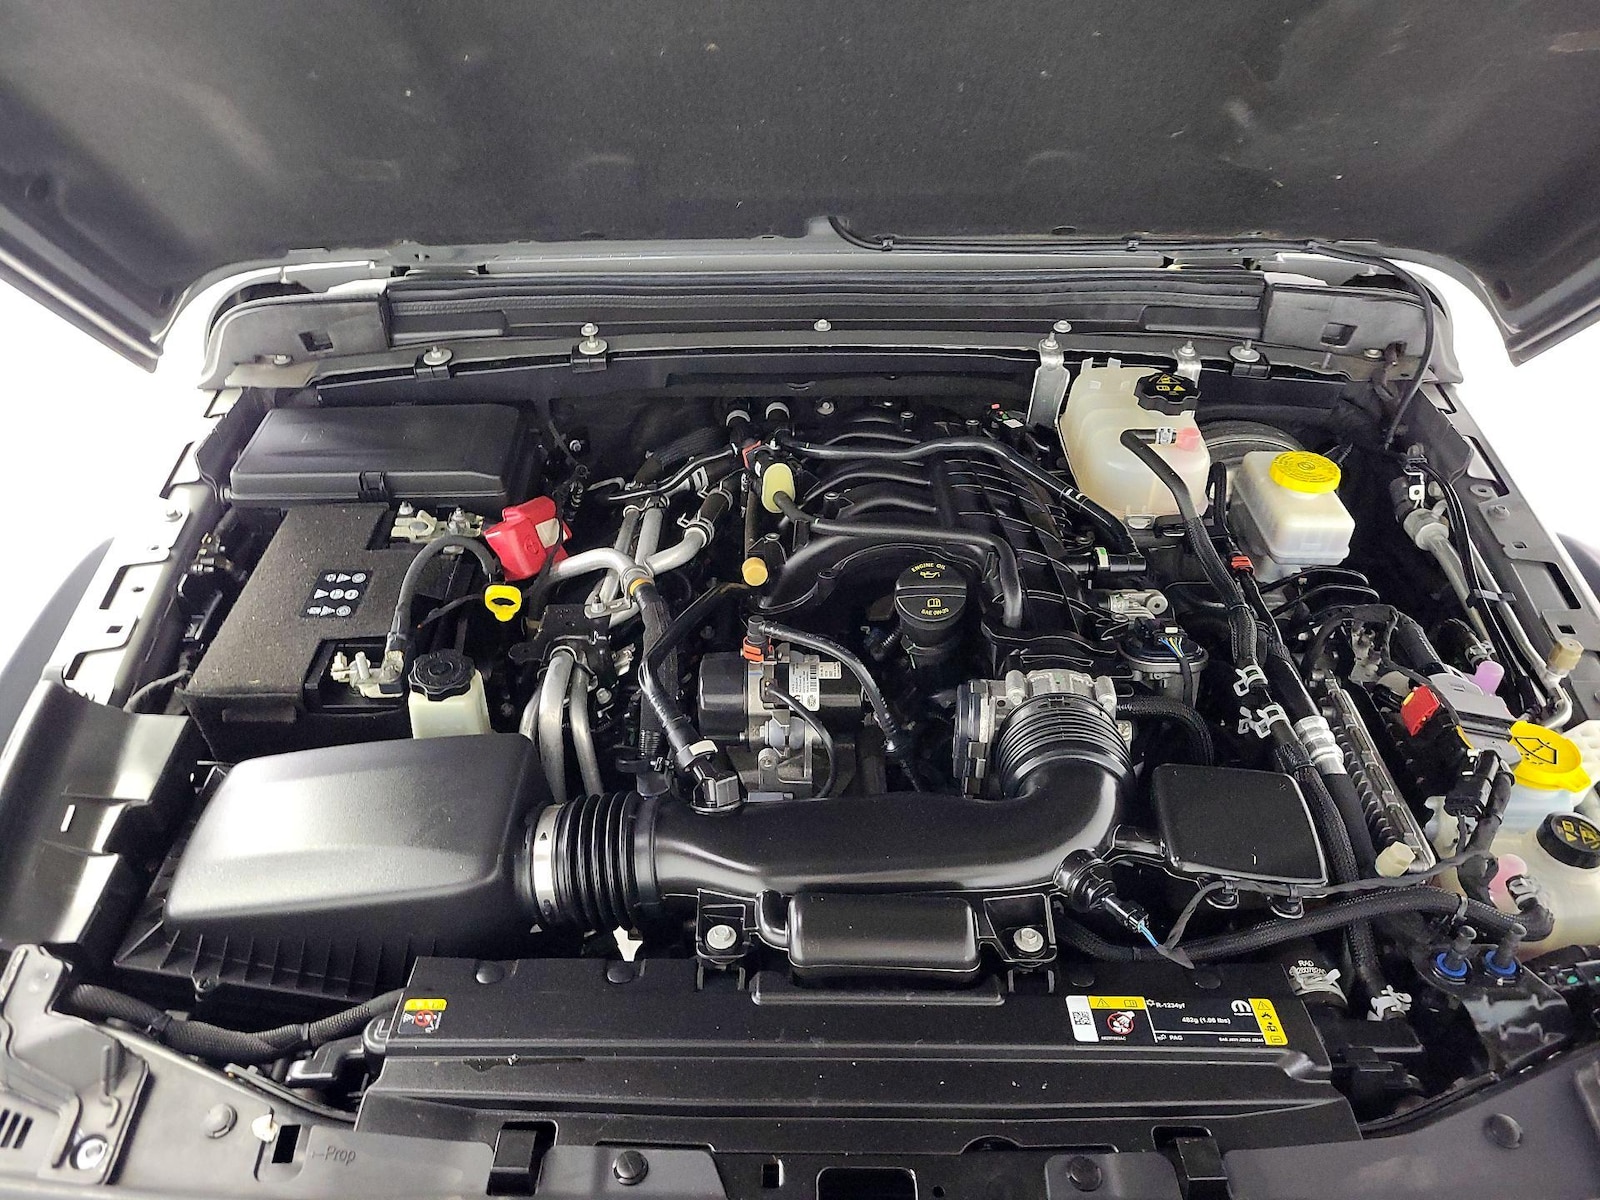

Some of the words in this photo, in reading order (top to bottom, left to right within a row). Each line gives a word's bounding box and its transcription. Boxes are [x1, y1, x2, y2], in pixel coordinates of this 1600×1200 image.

[911, 562, 935, 573] ENGINE
[936, 563, 947, 571] OIL
[1297, 959, 1315, 967] RAD
[325, 1145, 356, 1166] Prop
